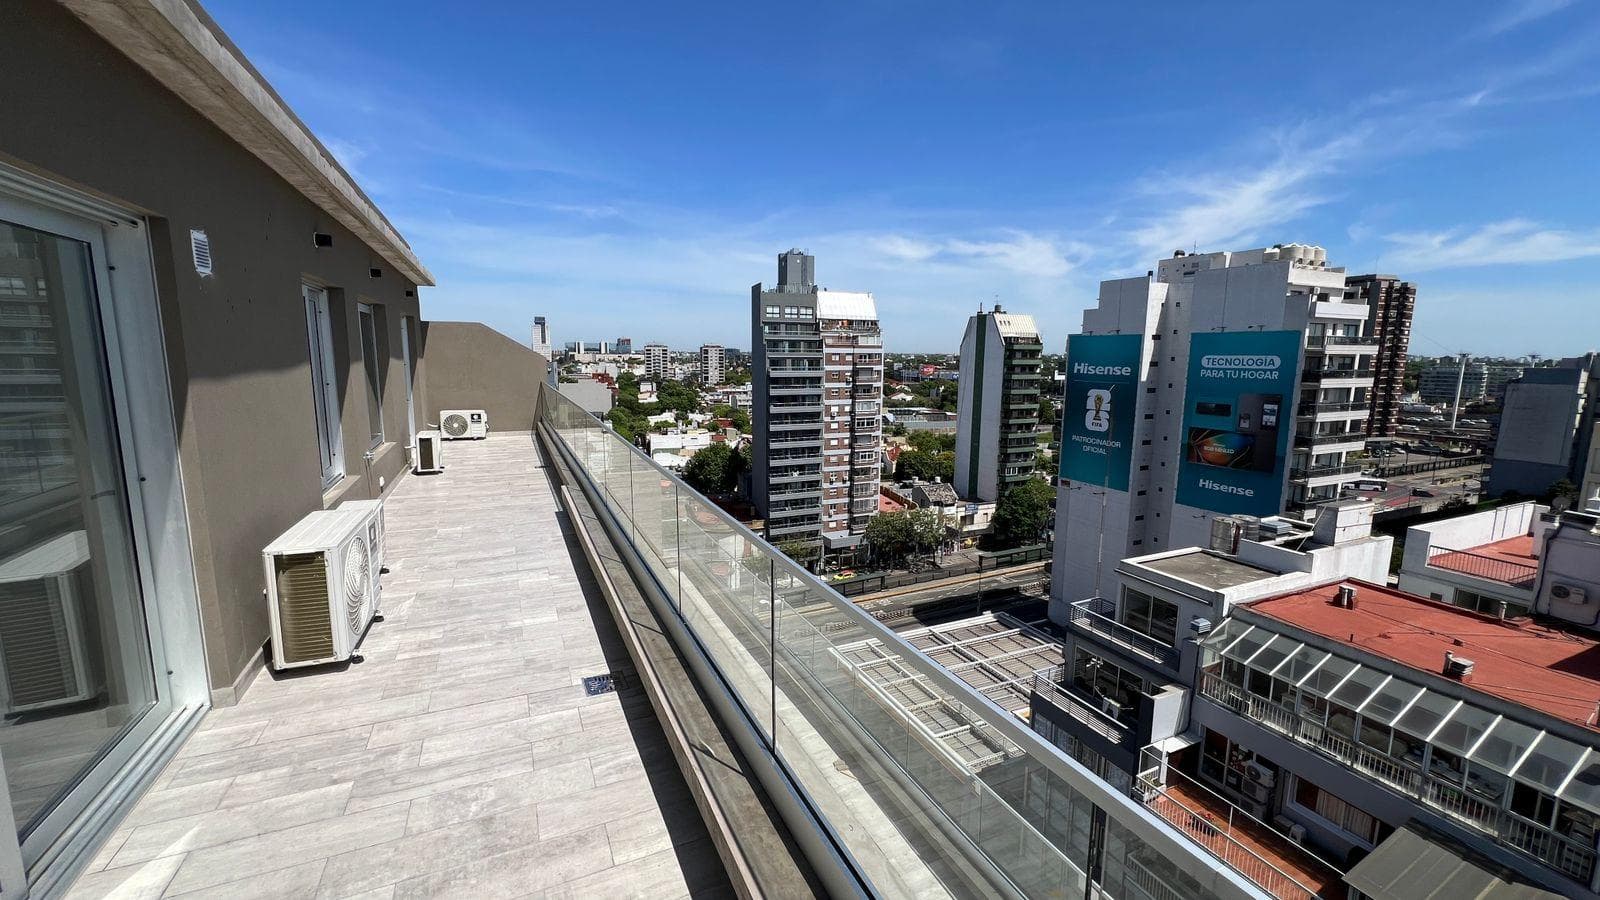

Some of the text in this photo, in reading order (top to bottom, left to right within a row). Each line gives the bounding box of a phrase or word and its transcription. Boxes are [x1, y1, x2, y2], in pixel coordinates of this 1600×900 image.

[1073, 362, 1131, 376] Hisense
[1200, 369, 1279, 380] PARA TU HOGAR
[1072, 434, 1121, 449] PATROCINADOR
[1082, 445, 1107, 455] OFICIAL
[1198, 478, 1254, 497] Hisense
